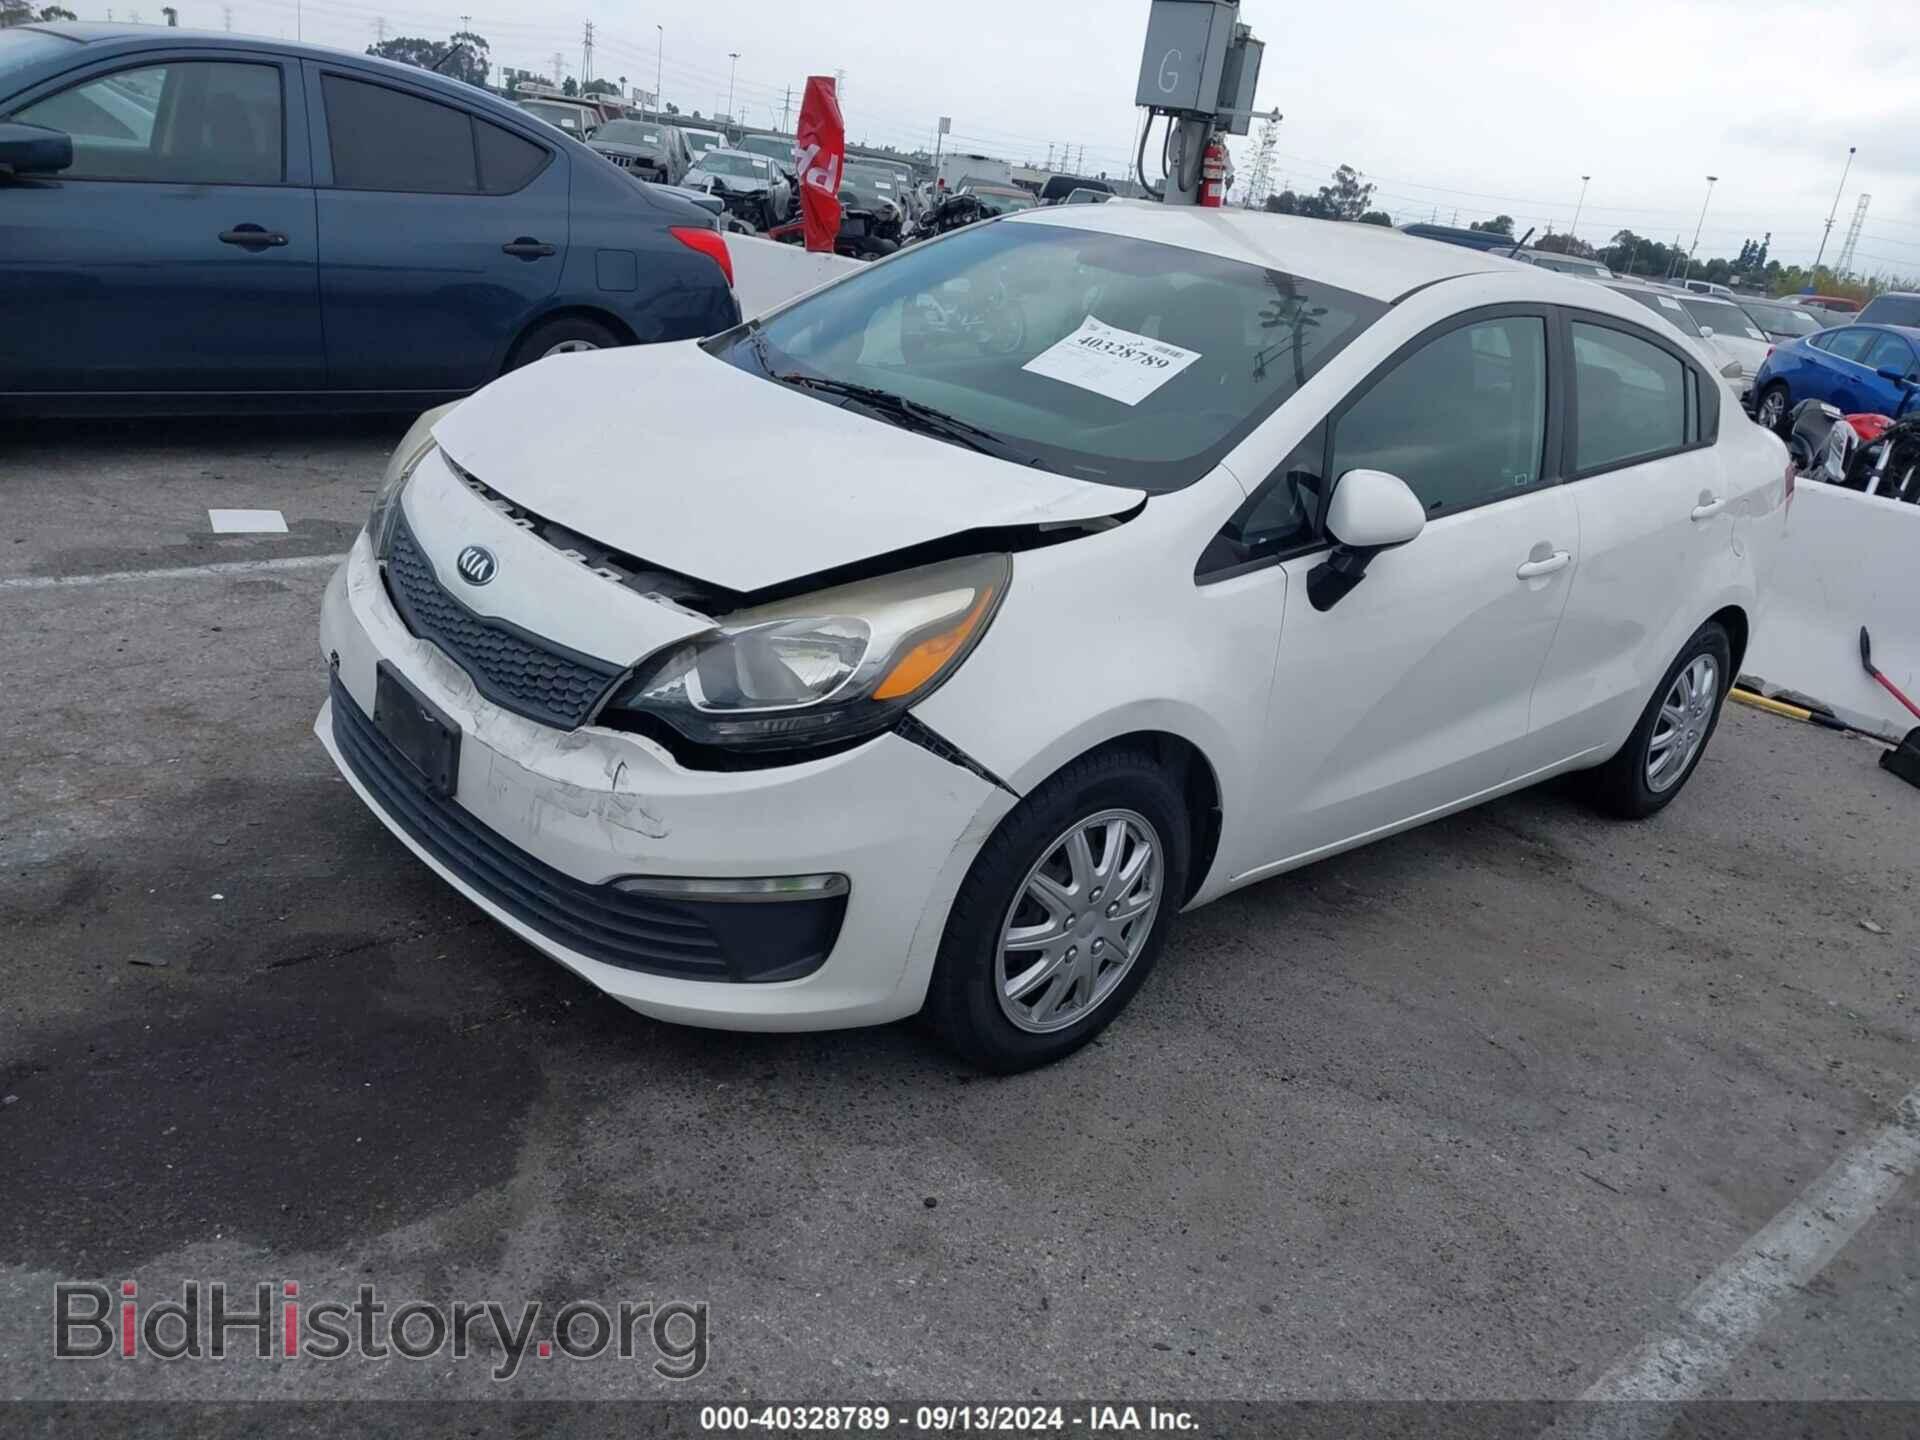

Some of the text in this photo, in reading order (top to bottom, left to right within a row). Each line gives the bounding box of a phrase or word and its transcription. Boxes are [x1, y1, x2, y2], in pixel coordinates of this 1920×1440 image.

[1158, 49, 1182, 93] G
[1077, 336, 1170, 368] 40328789
[460, 548, 489, 580] KIA
